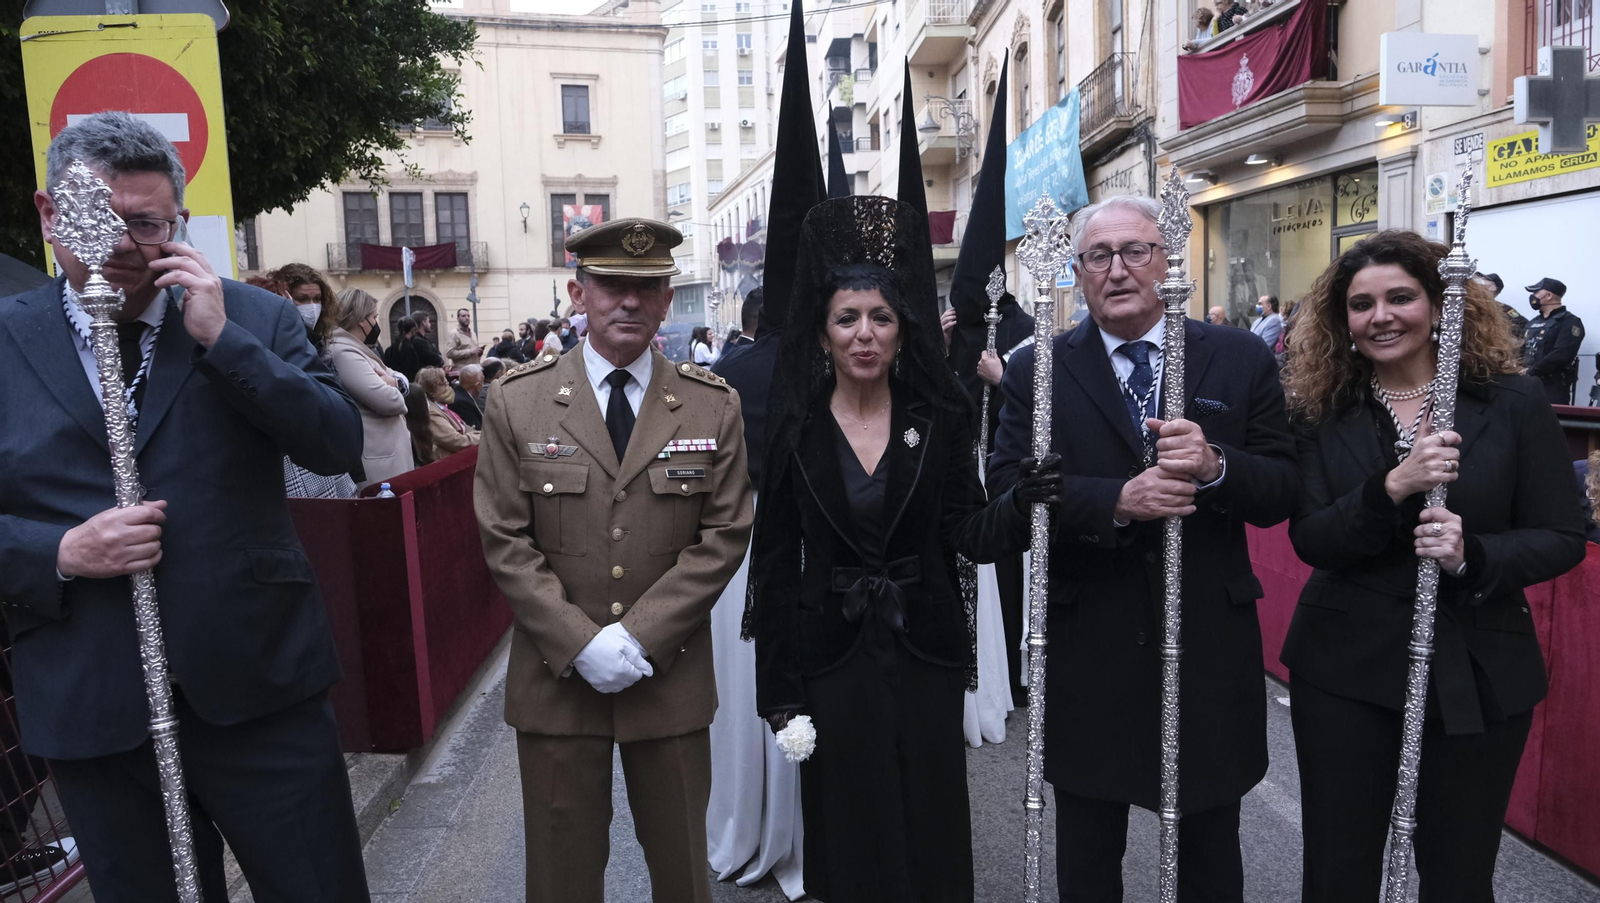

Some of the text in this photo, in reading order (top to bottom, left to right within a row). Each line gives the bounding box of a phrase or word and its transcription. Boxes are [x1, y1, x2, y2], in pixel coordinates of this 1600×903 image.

[1404, 113, 1411, 129] 8
[1455, 133, 1483, 155] SE VENDE
[1493, 153, 1597, 182] LLAMAMOS GRUA
[1500, 160, 1518, 170] NO
[1273, 219, 1323, 235] FOTÓGRAFOS
